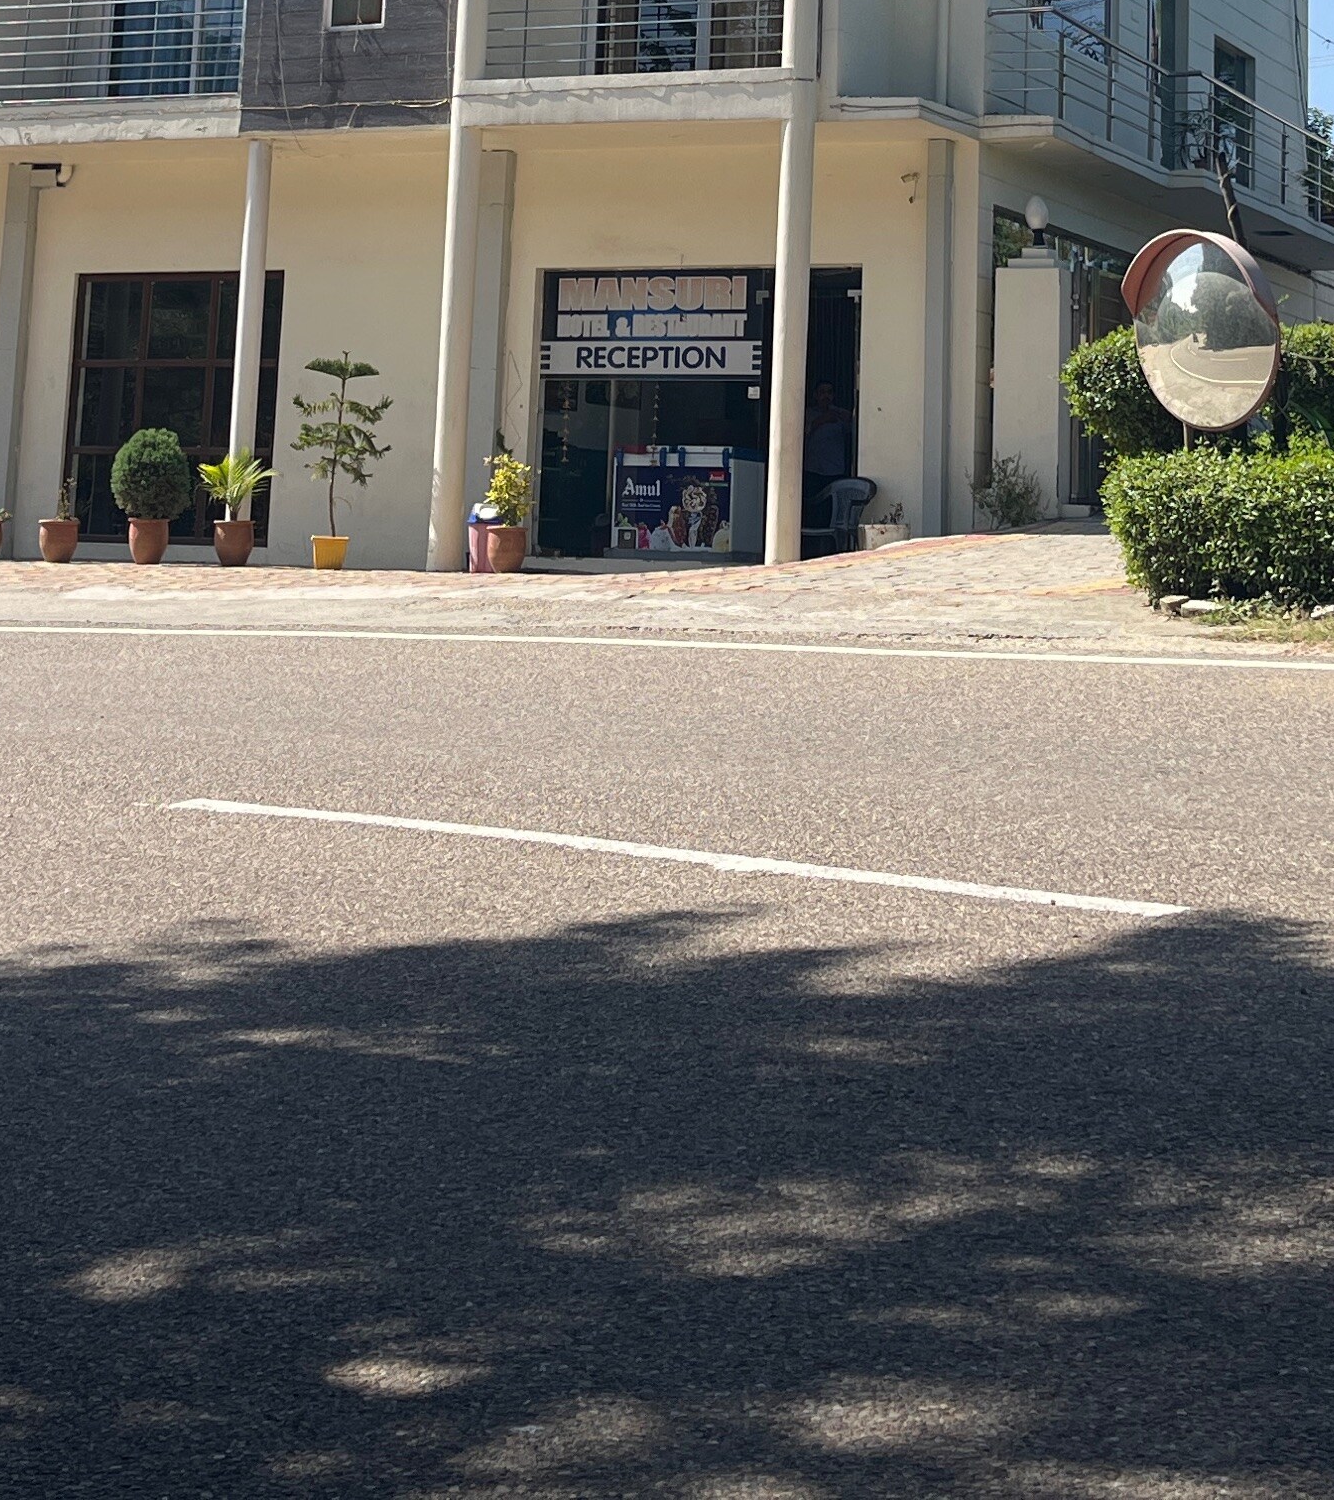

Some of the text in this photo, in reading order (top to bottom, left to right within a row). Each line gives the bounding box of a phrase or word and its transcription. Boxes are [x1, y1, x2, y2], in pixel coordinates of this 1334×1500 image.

[557, 276, 748, 311] MANSURI
[615, 316, 631, 337] &
[576, 346, 726, 369] RECEPTION
[622, 477, 661, 497] Amul
